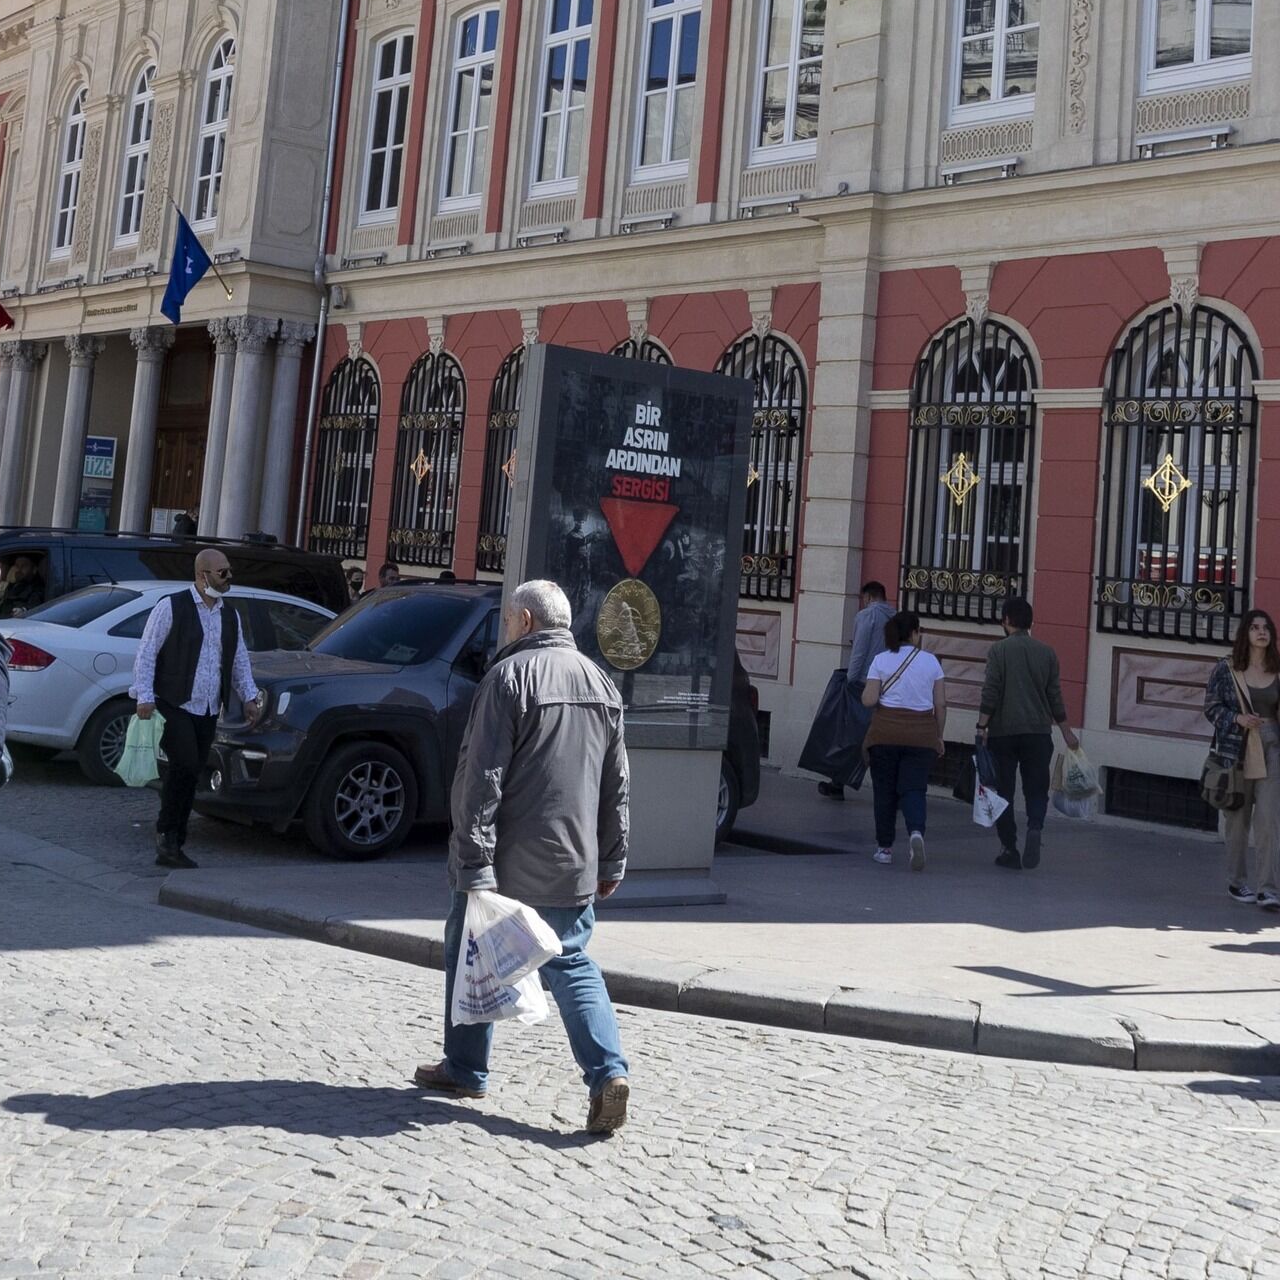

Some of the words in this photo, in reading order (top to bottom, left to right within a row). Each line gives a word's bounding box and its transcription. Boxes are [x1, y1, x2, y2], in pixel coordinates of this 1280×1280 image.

[635, 400, 662, 427] BİR
[623, 426, 670, 452] ASRIN
[605, 448, 681, 478] ARDINDAN
[611, 474, 671, 501] SERGİSİ
